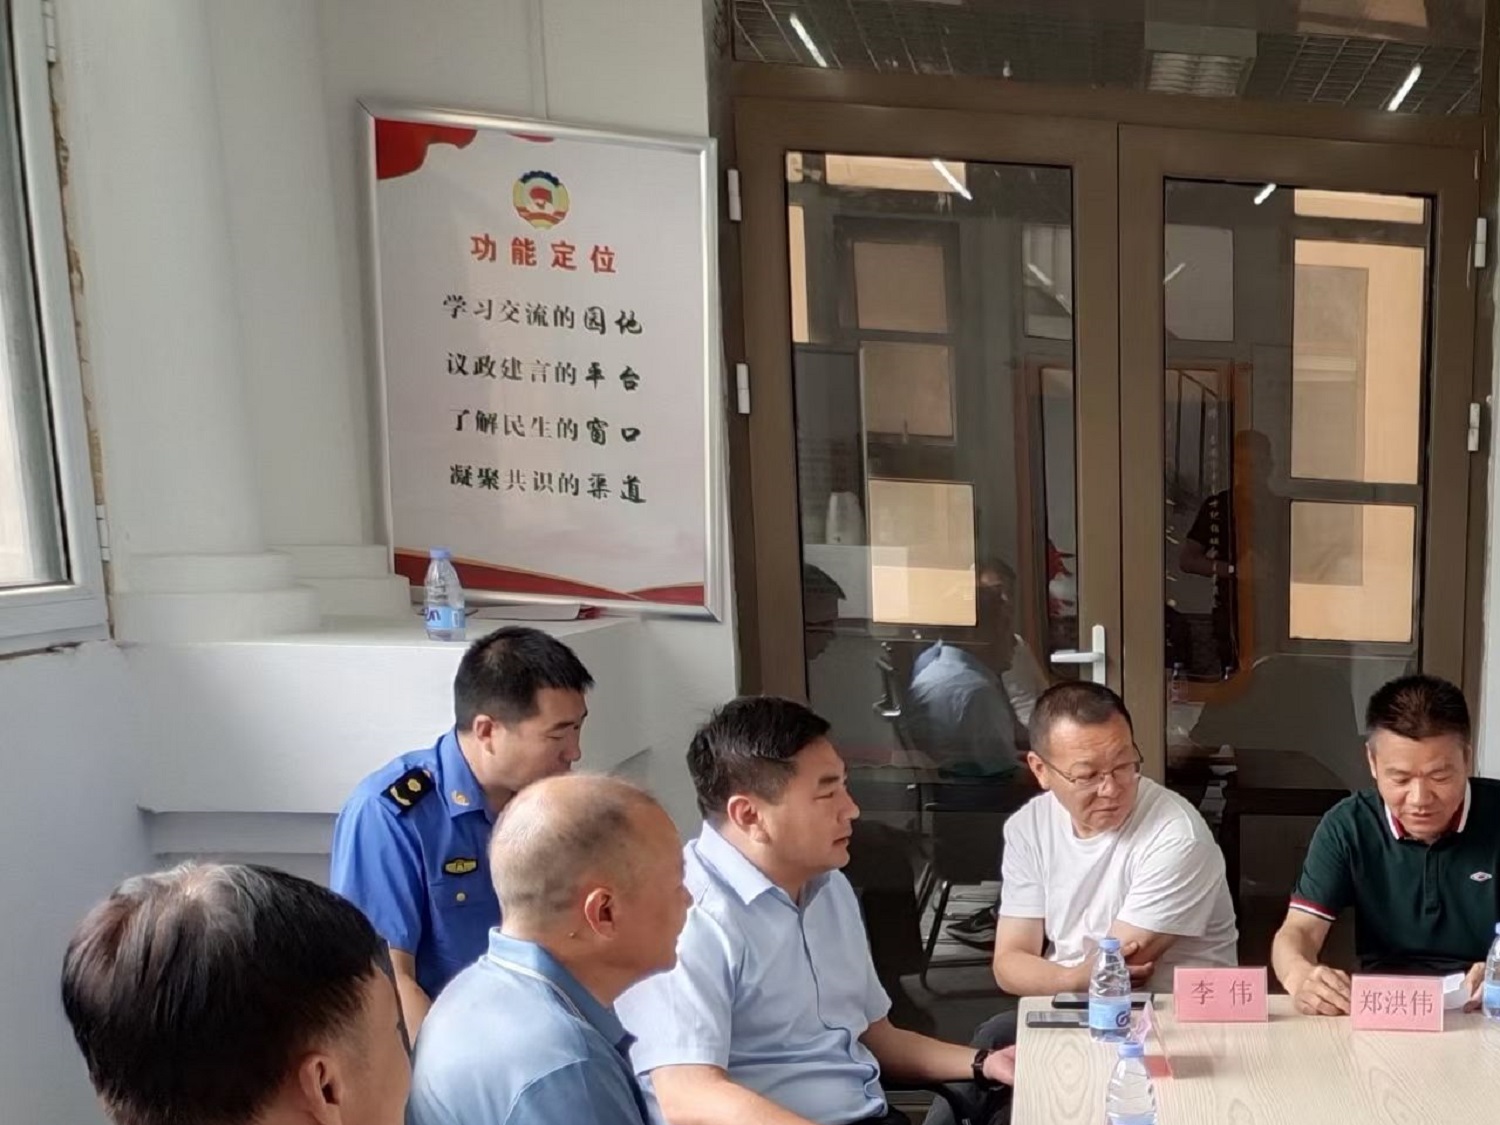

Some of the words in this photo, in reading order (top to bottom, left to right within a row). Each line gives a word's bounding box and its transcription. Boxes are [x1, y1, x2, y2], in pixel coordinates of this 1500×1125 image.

[470, 234, 617, 274] 功能定位
[443, 295, 643, 335] 学习交流的园地
[446, 352, 641, 391] 议政建言的平台
[449, 408, 641, 444] 了解民生的窗口
[450, 464, 646, 503] 凝聚共识的渠道
[1359, 990, 1434, 1017] 郑洪伟
